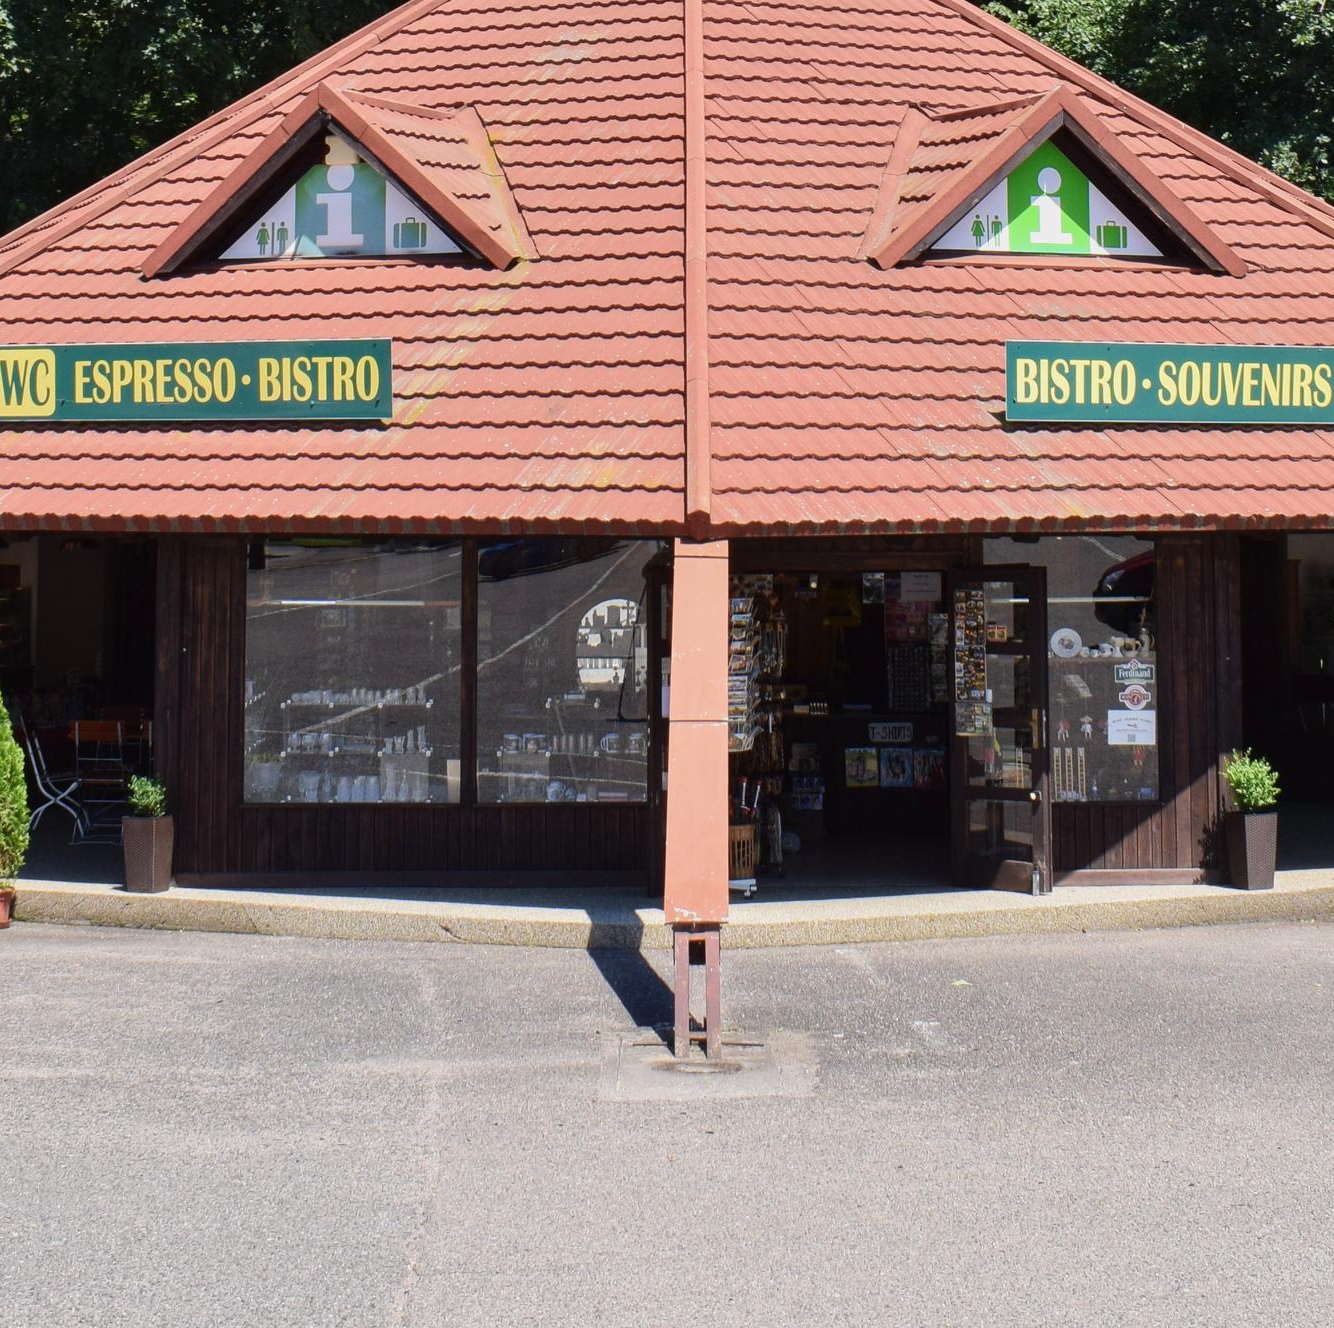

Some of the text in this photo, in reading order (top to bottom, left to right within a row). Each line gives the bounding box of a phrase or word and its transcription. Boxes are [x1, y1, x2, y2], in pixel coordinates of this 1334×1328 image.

[0, 355, 380, 407] WC ESPRESSO BISTRO
[1016, 358, 1137, 405] BISTRO
[1157, 360, 1333, 408] SOUVENIRS
[1118, 668, 1151, 678] Ferdinand
